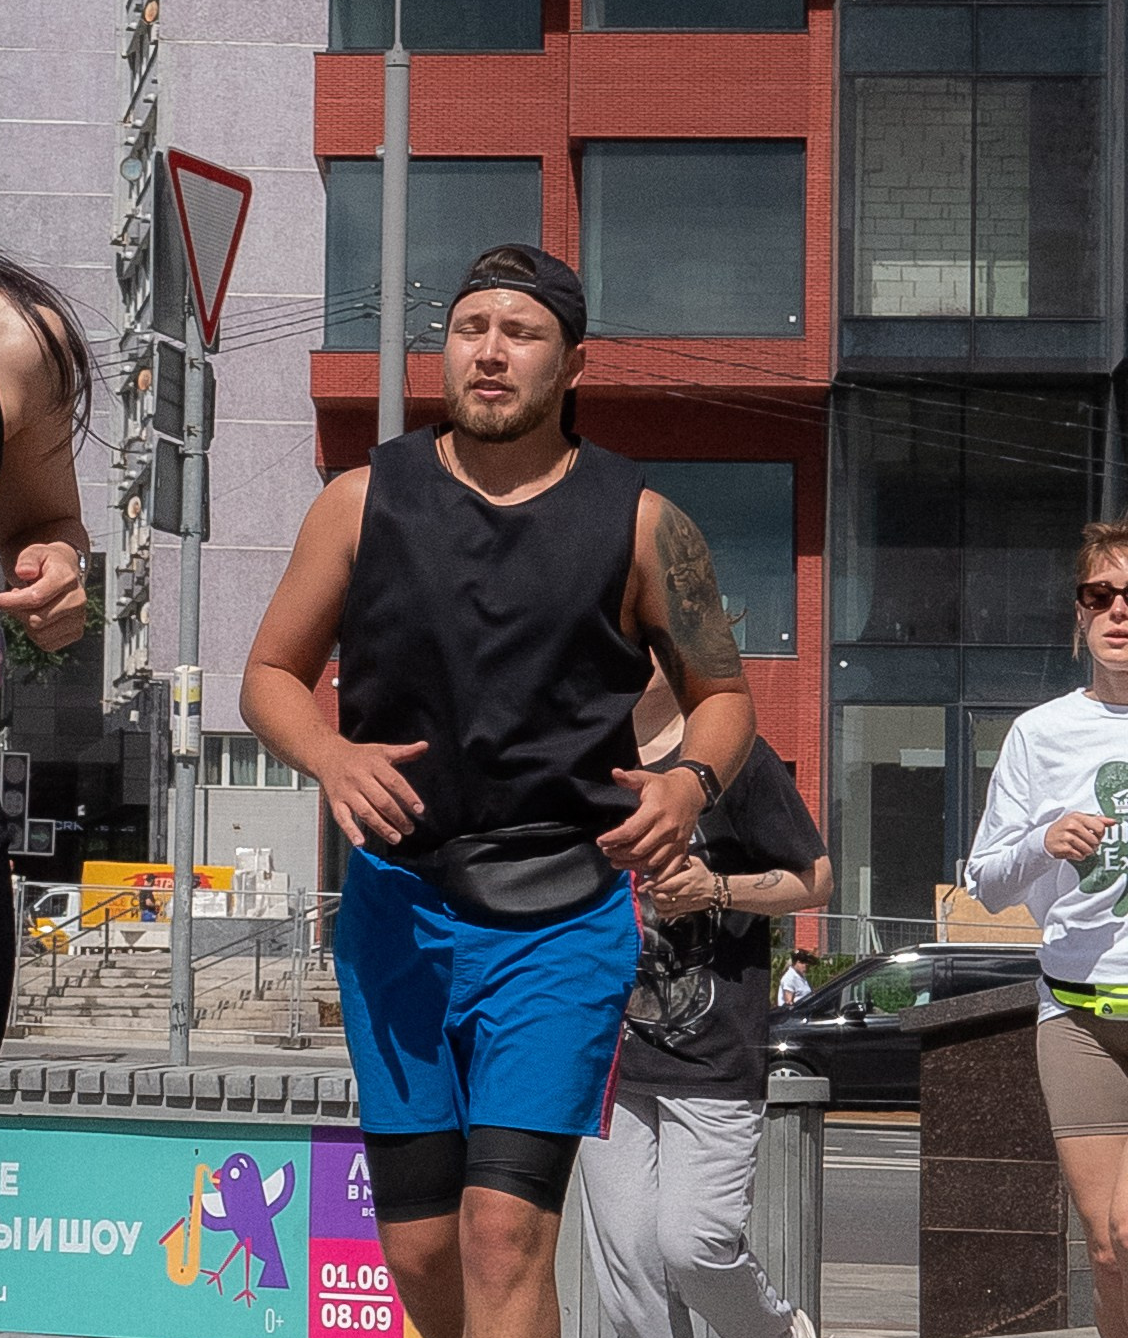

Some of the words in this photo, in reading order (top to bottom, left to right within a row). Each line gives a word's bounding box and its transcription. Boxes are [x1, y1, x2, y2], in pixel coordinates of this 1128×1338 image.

[28, 1217, 53, 1252] И
[59, 1218, 143, 1256] ШОУ
[321, 1263, 390, 1291] 01.06
[264, 1308, 285, 1334] 0+
[321, 1303, 392, 1331] 08.09
